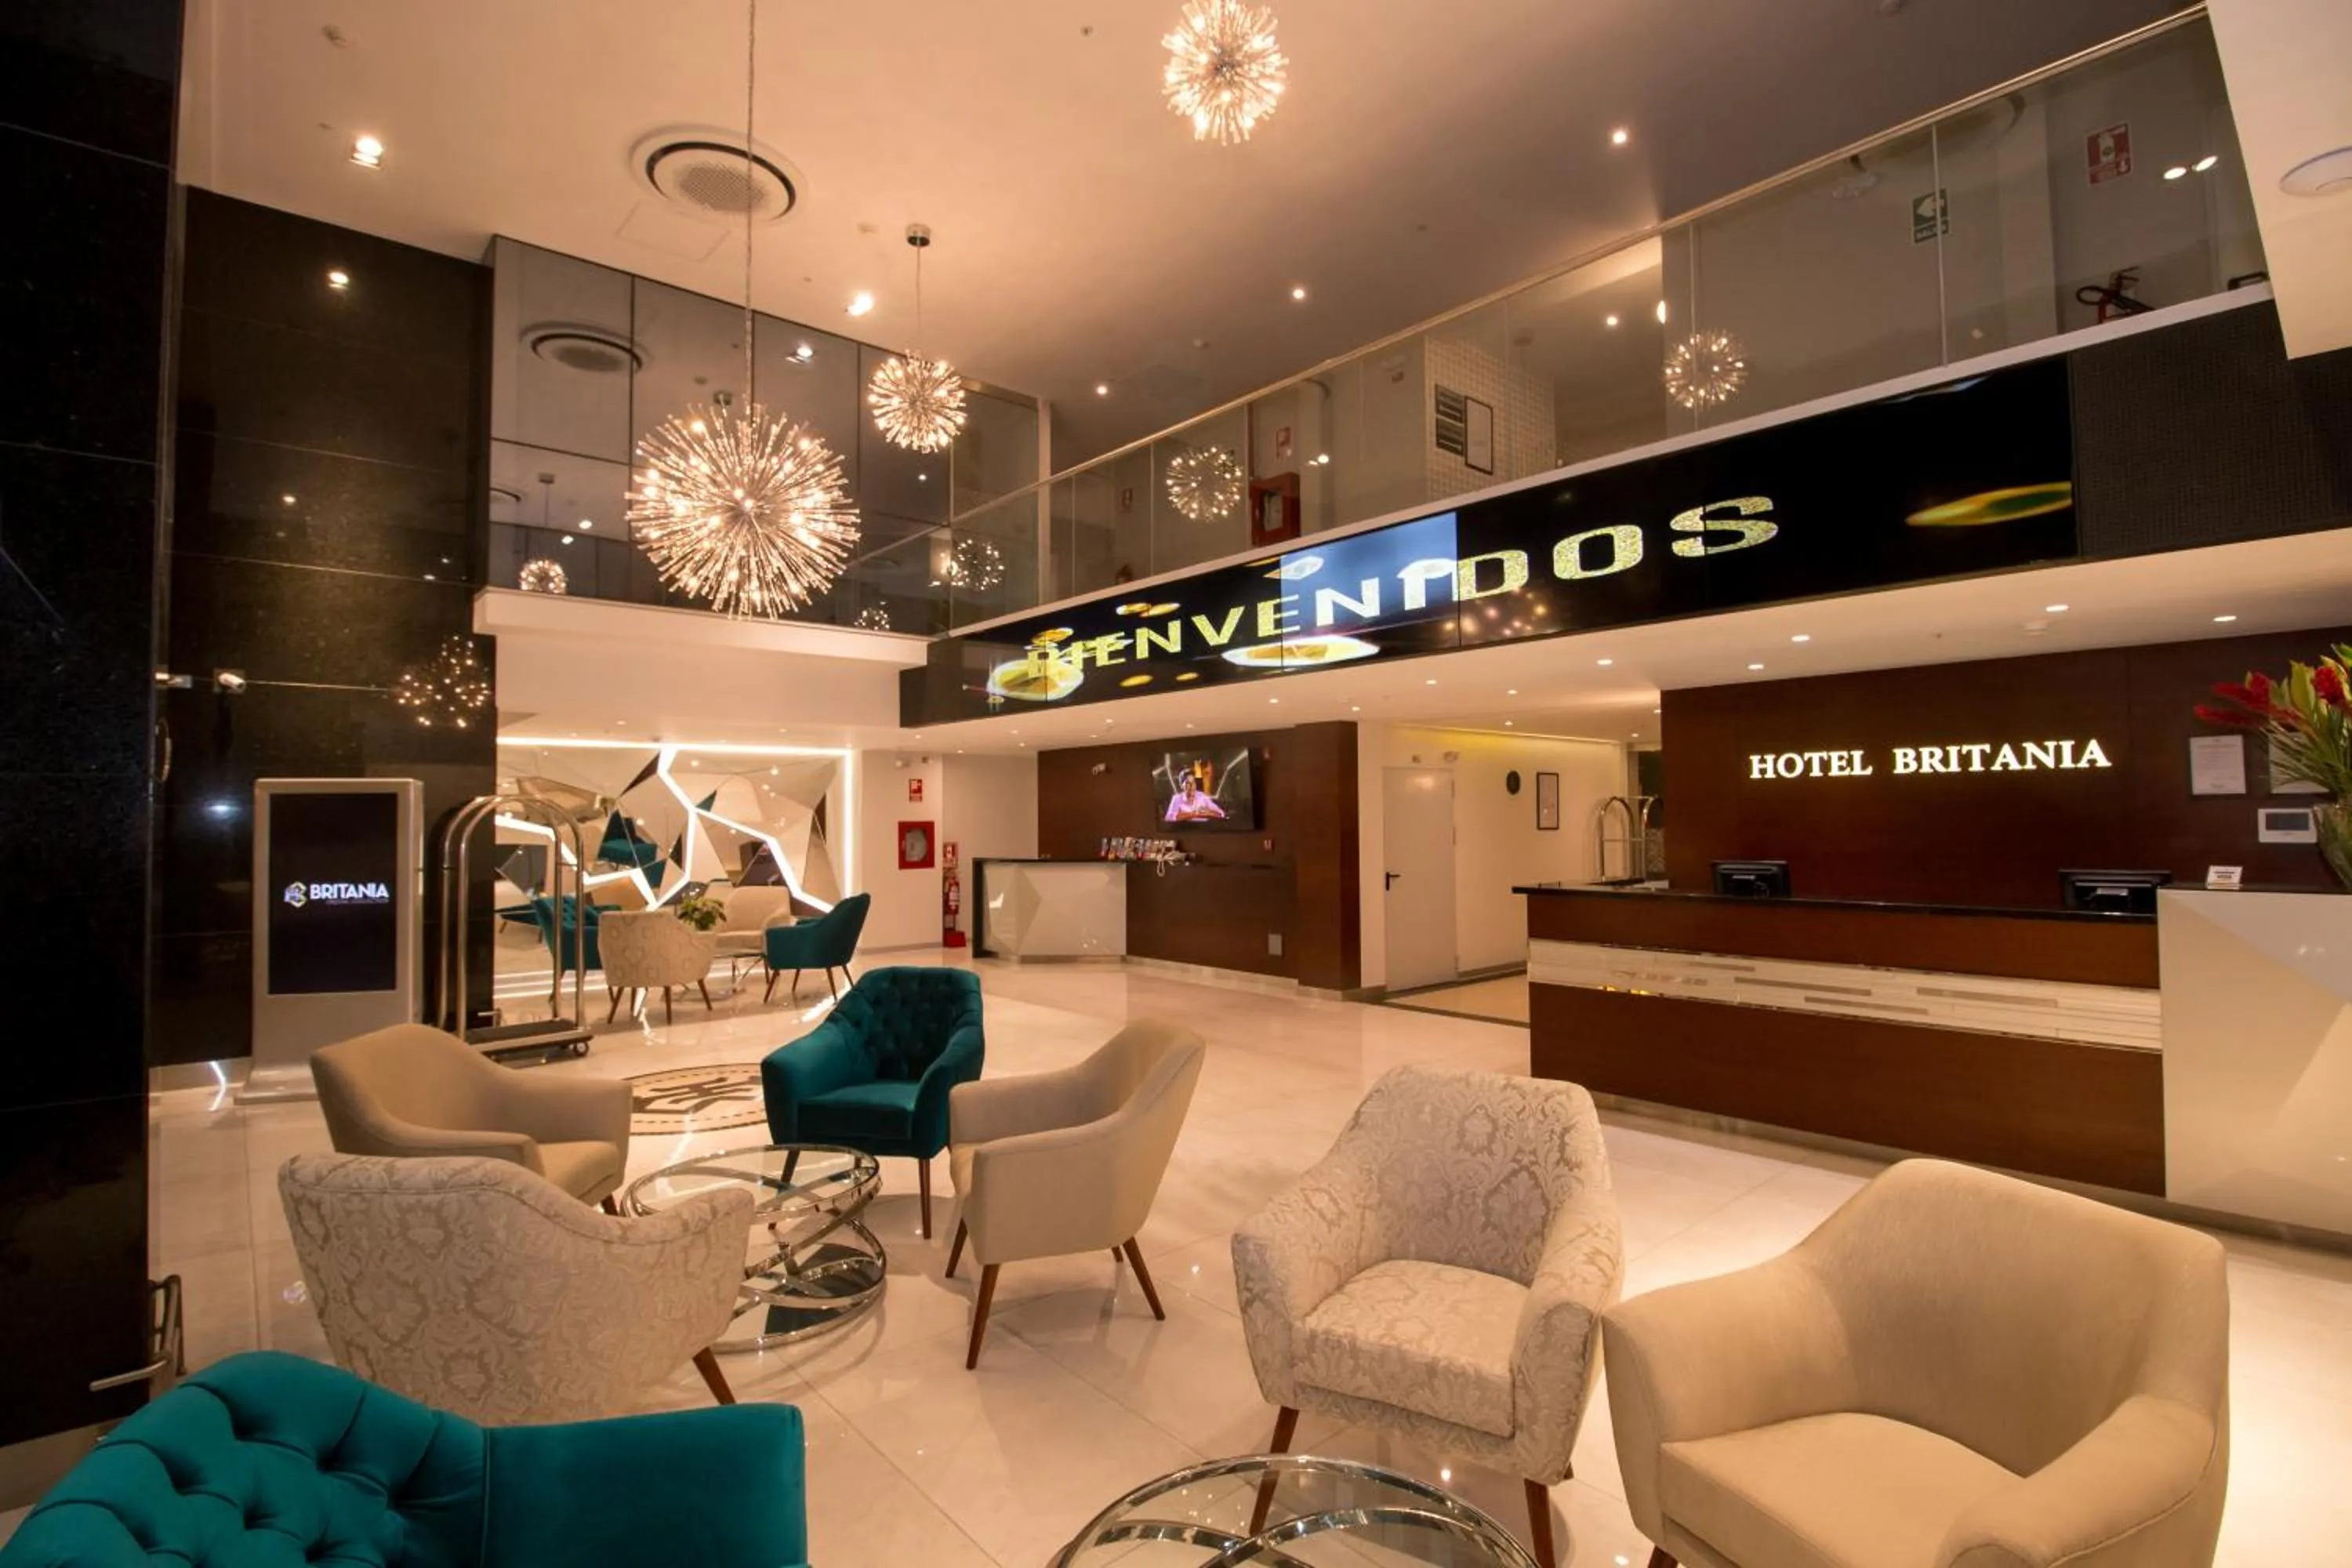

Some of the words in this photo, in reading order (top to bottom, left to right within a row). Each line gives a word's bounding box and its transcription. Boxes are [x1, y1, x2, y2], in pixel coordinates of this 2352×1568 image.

[1749, 750, 1873, 779] HOTEL
[1892, 739, 2112, 775] BRITANIA
[309, 883, 390, 900] BRITANIA
